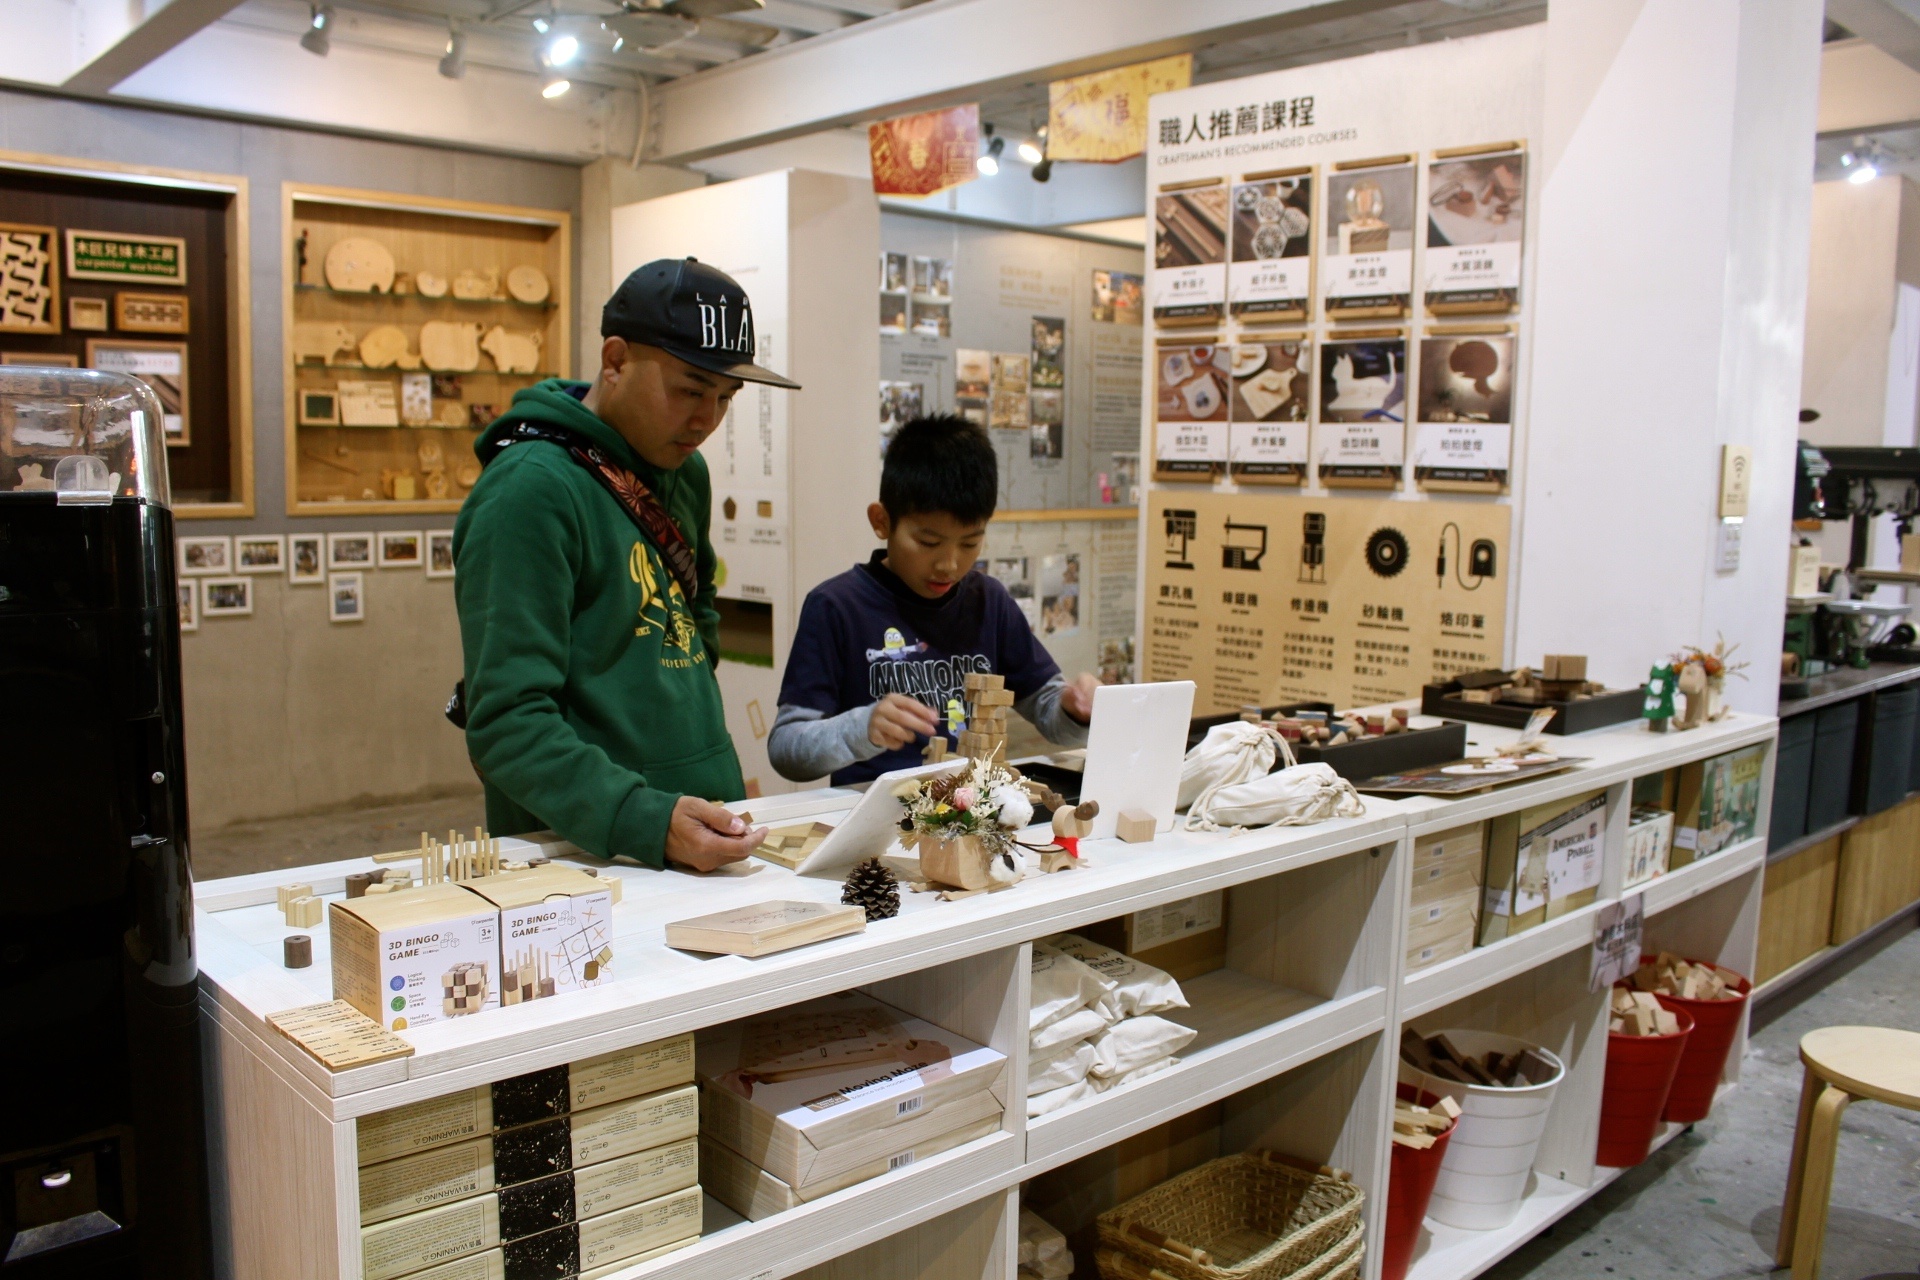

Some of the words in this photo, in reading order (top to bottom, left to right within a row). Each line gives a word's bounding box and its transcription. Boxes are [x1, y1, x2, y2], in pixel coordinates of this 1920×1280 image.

[1158, 96, 1315, 147] 職人推薦課程
[1157, 147, 1222, 166] CRAFTSMAN'S
[1224, 136, 1305, 156] RECOMMENDED
[1307, 127, 1359, 145] COURSES
[76, 259, 126, 270] carpenter
[129, 261, 176, 275] workshop
[699, 304, 755, 354] BLA
[1362, 604, 1404, 622] 砂輪機
[1440, 611, 1485, 629] 烙印筆
[869, 654, 992, 698] MINIONS
[511, 919, 524, 928] 3D
[526, 912, 557, 925] BINGO
[481, 928, 491, 937] 3+
[511, 926, 540, 938] GAME
[388, 941, 402, 950] 3D
[405, 933, 439, 947] BINGO
[389, 948, 420, 961] GAME
[410, 1017, 437, 1026] Coordination
[839, 1074, 893, 1095] Moving
[890, 1061, 928, 1077] Maze
[422, 1129, 460, 1143] WARNING
[424, 1187, 462, 1203] WARNING
[430, 1245, 468, 1260] WARNING
